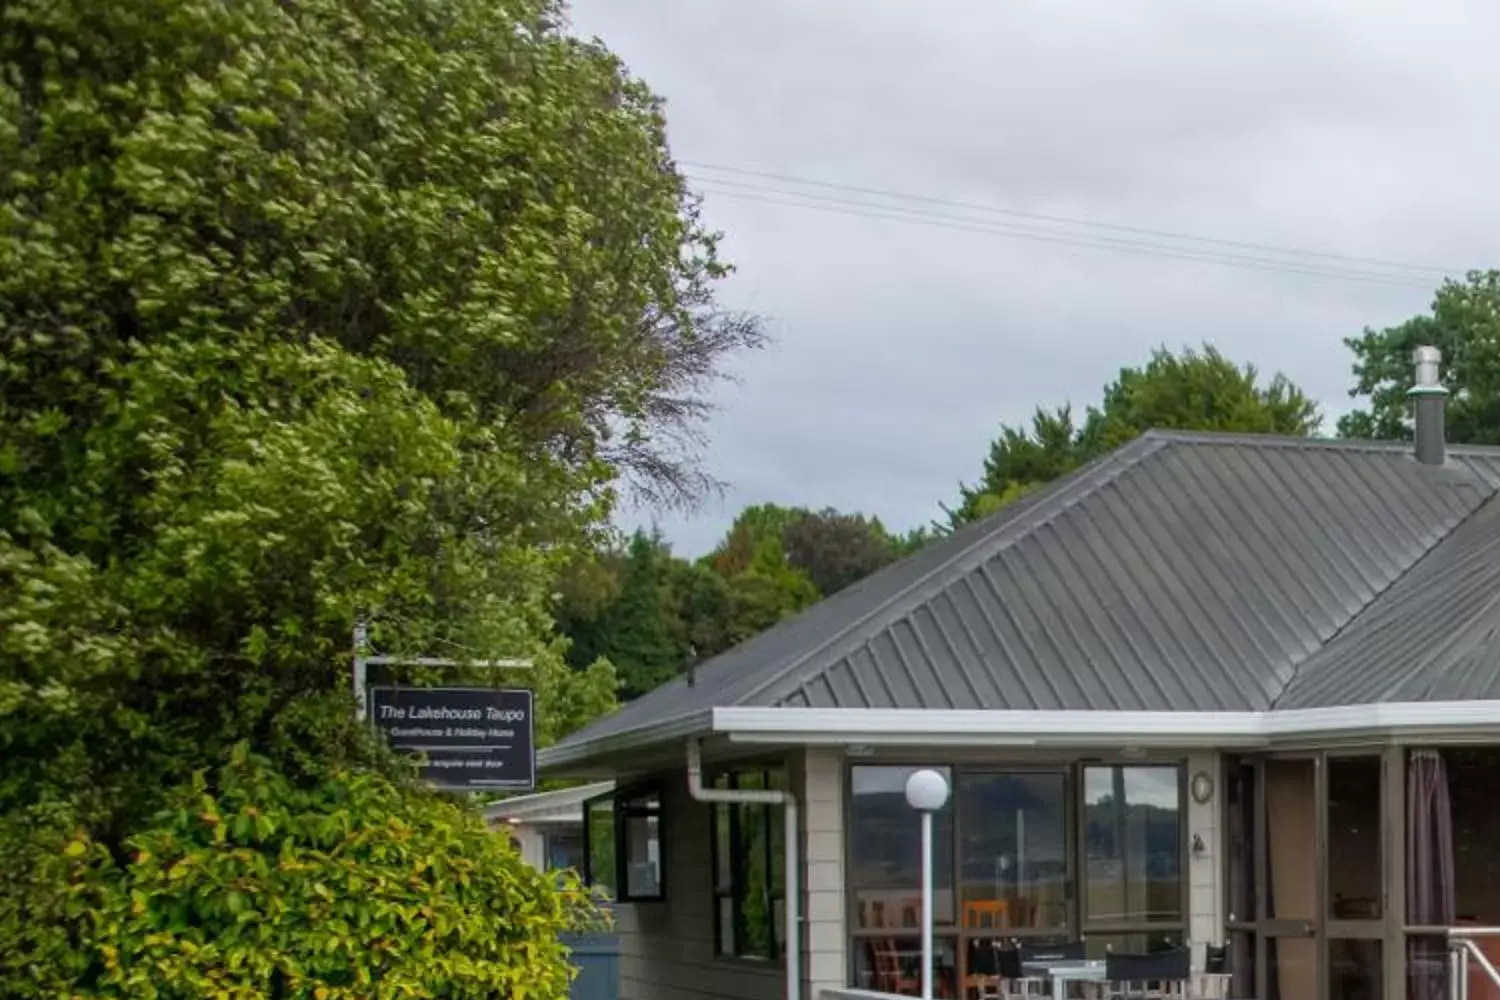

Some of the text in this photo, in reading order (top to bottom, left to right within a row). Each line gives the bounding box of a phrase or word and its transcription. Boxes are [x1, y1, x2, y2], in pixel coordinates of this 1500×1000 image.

[380, 705, 525, 723] The Lakehouse Taupo
